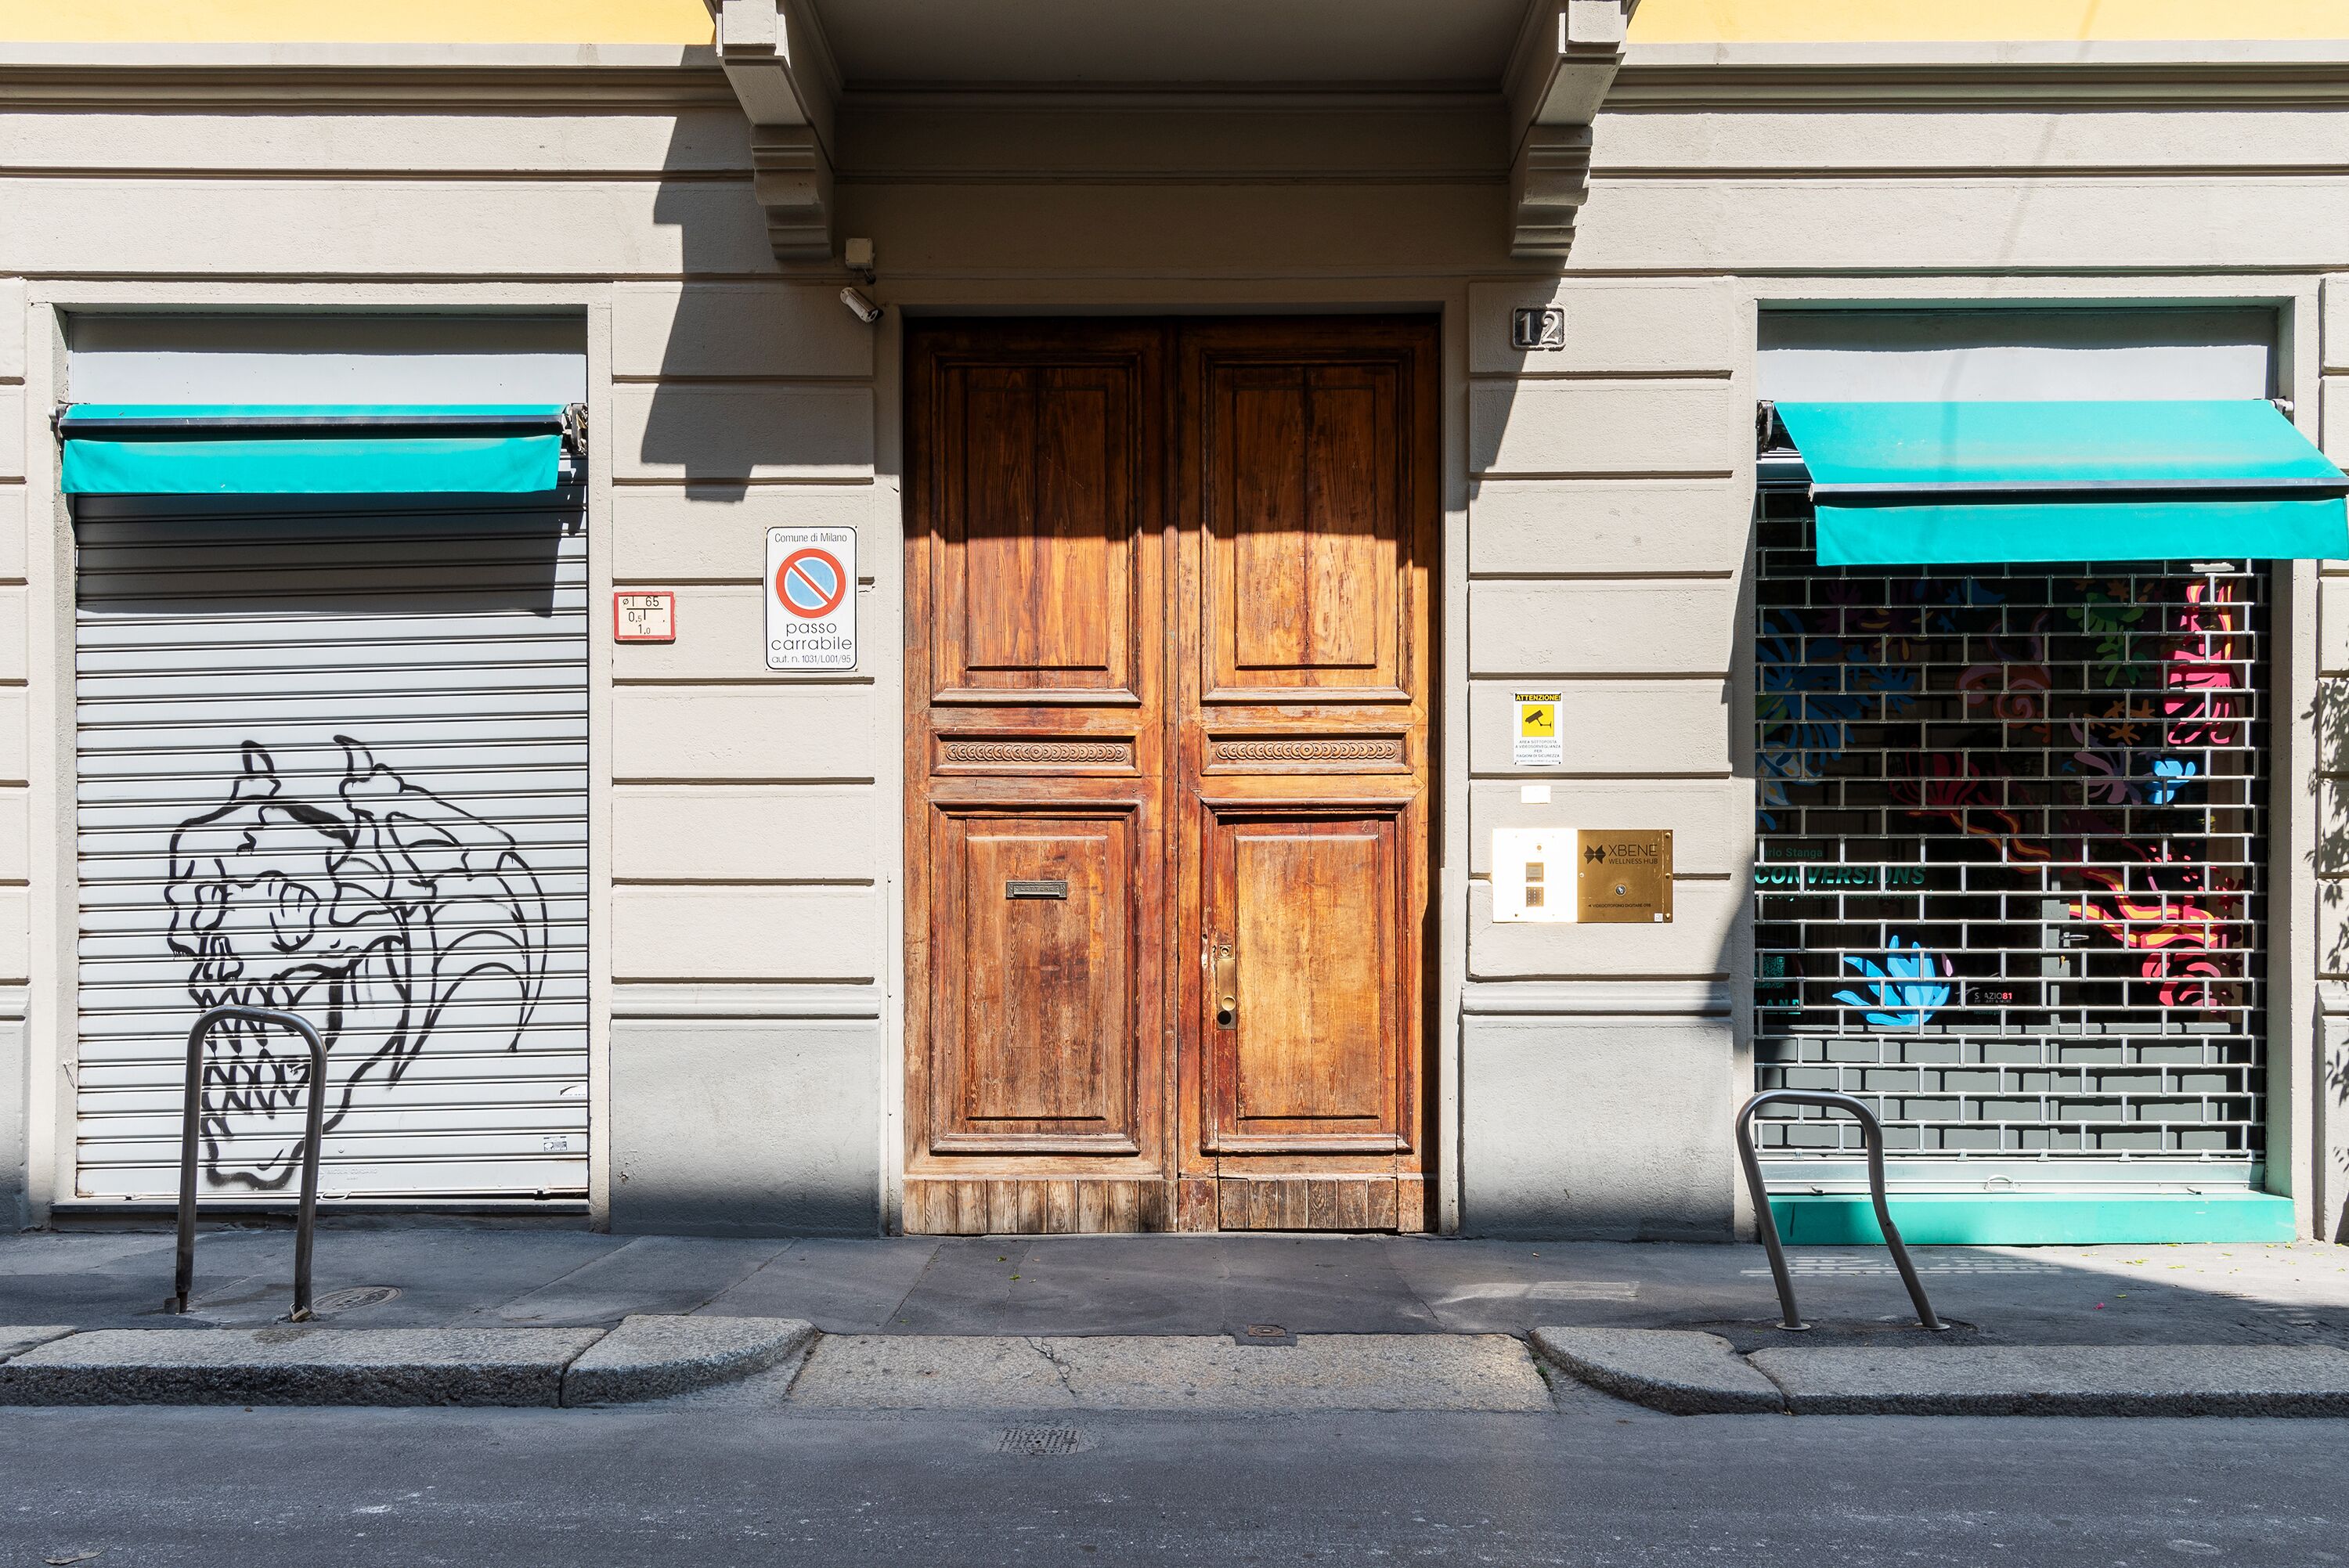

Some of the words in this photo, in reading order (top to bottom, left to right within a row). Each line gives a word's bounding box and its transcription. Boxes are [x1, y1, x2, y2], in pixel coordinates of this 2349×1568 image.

[1519, 310, 1560, 345] 12
[774, 533, 808, 542] Comune
[810, 532, 818, 542] di
[820, 532, 847, 542] Milano
[645, 596, 659, 607] 65
[786, 622, 837, 636] passo
[771, 636, 852, 651] carrabile
[771, 654, 789, 664] aut.
[802, 654, 851, 665] 1031/L001/95
[1608, 844, 1658, 856] XBENE
[1785, 847, 1824, 859] Stanga
